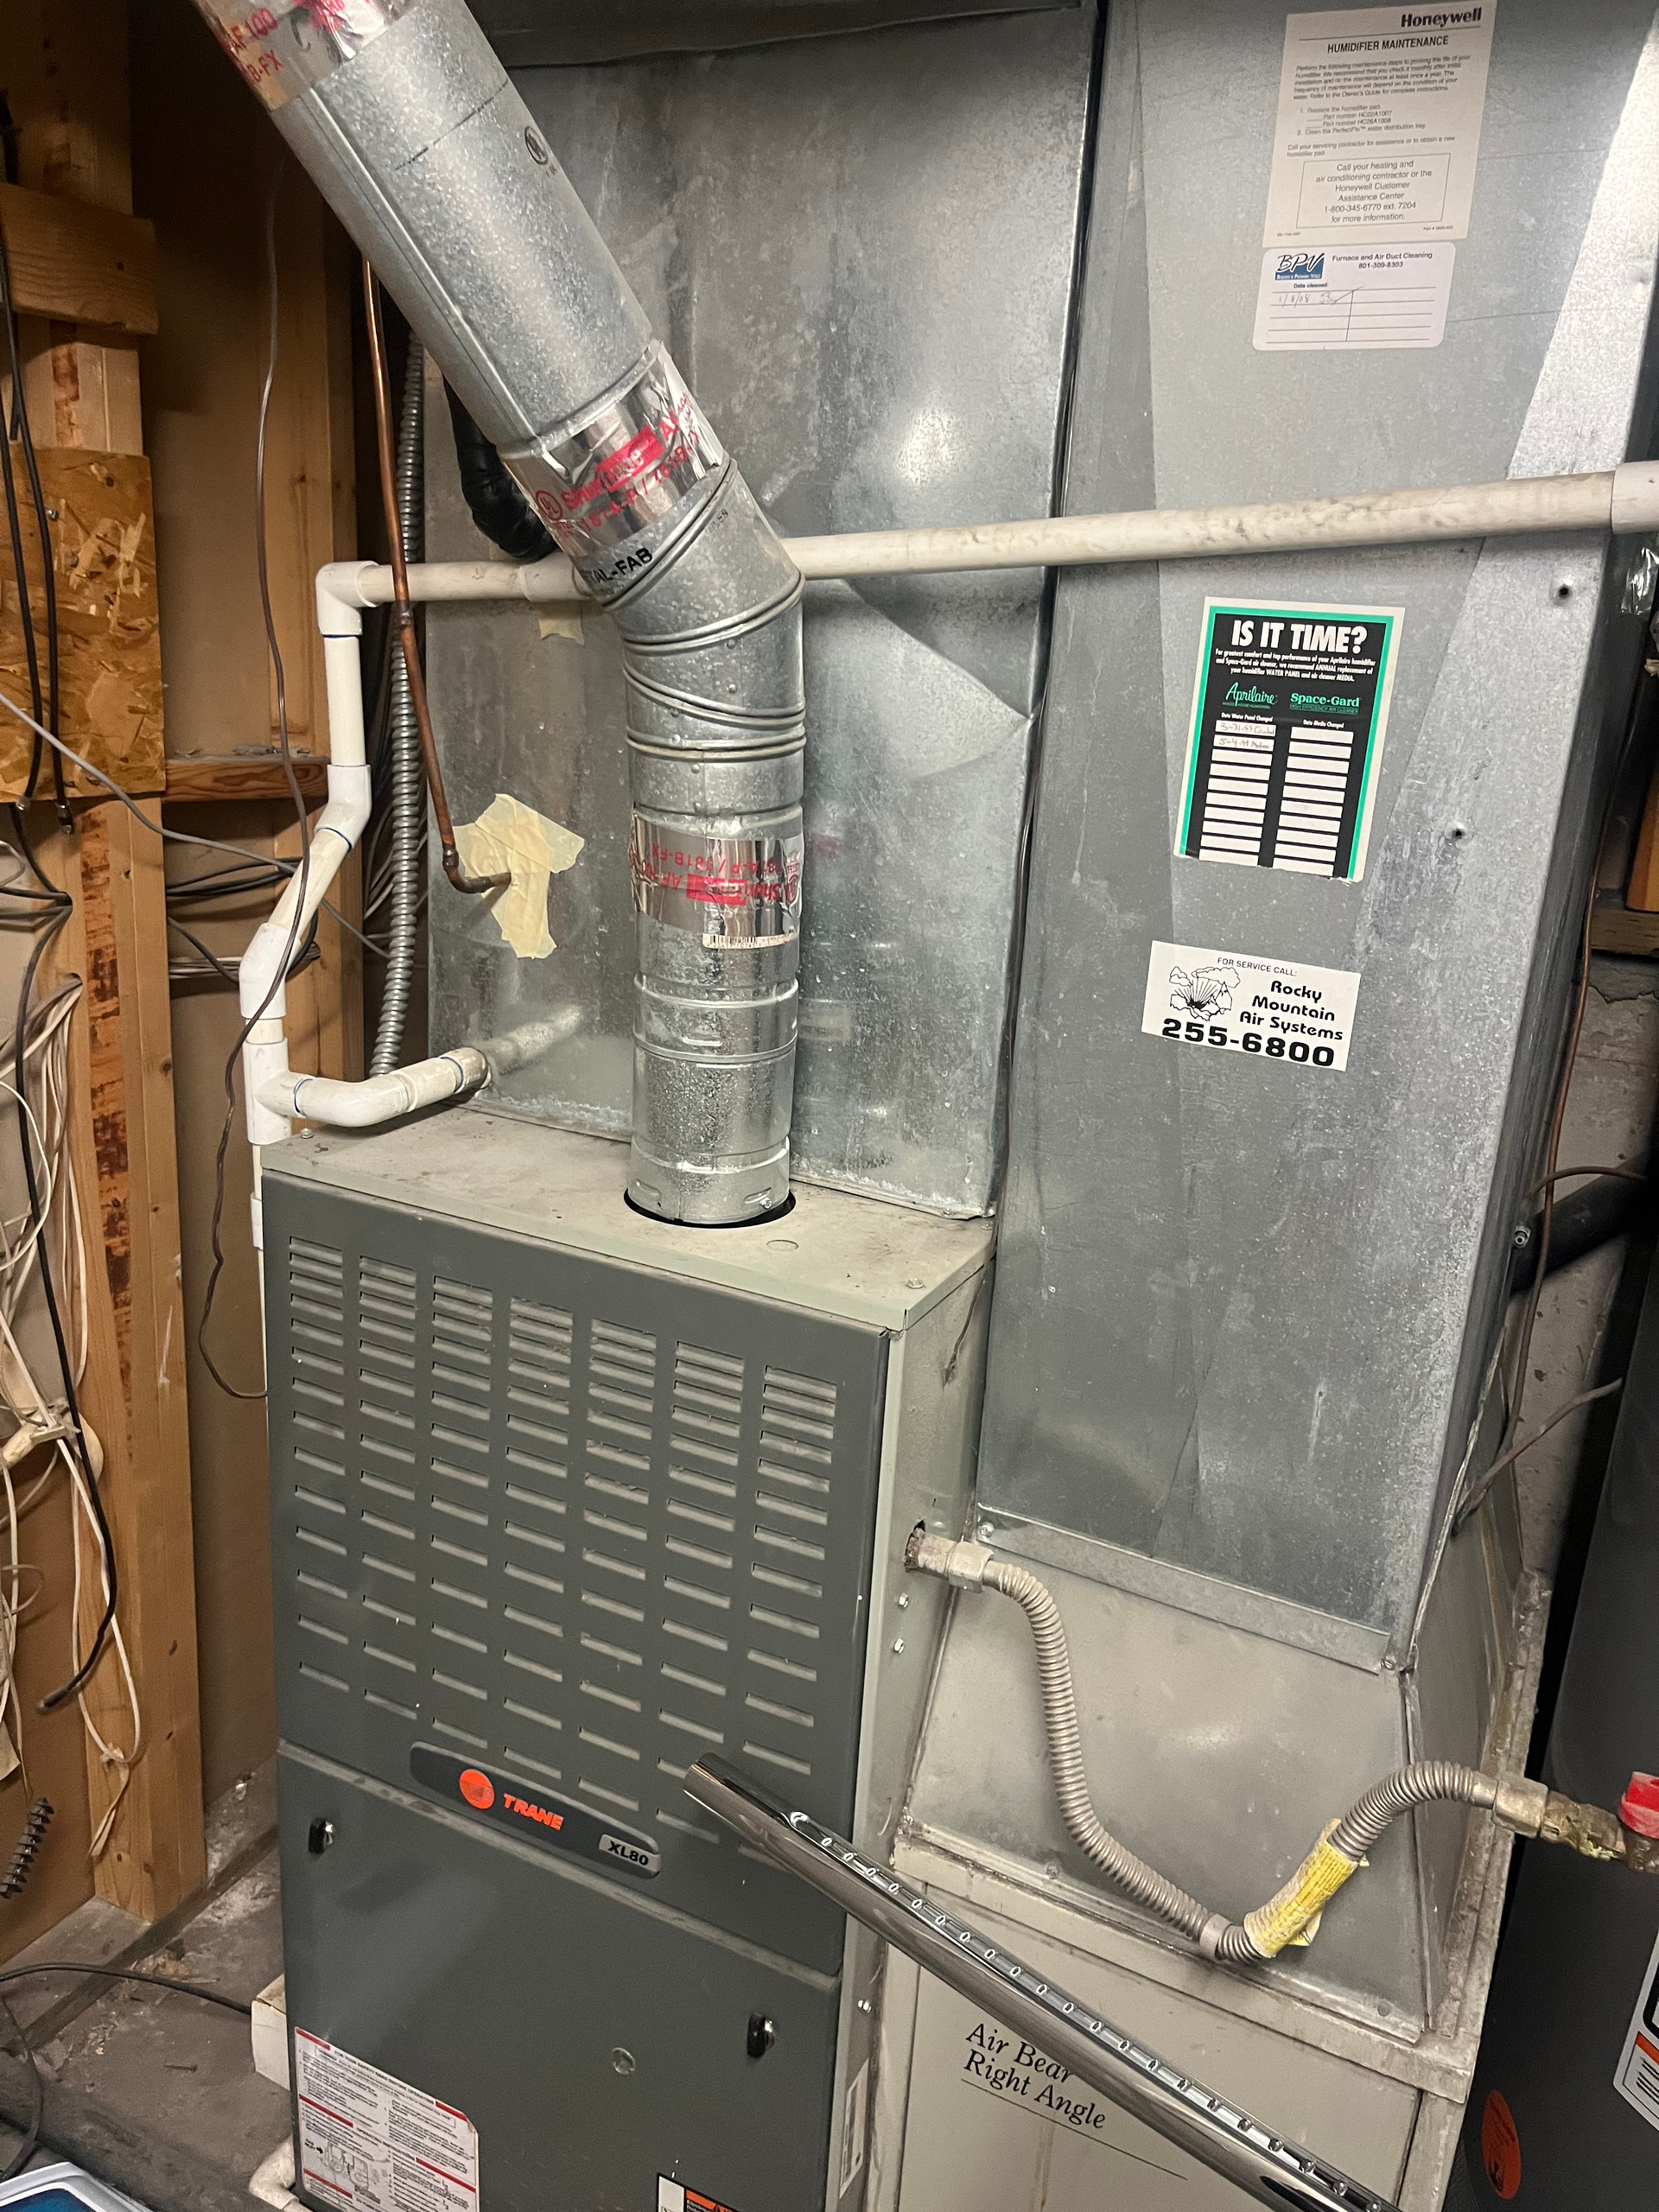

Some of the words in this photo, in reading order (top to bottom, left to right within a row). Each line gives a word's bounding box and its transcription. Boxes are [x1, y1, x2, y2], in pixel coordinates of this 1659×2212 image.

[245, 7, 278, 37] 100
[1401, 7, 1483, 28] Honeywell
[1327, 40, 1380, 54] HUMIDIFIER
[1382, 35, 1449, 50] MAINTENANCE
[1335, 183, 1372, 192] Honeywell
[1375, 181, 1410, 190] Customer
[1325, 204, 1381, 213] 1-800-345-6770
[1278, 252, 1325, 272] BPV
[1231, 620, 1255, 646] IS
[1260, 622, 1285, 648] IT
[1290, 624, 1368, 654] TIME?
[1225, 682, 1277, 707] Aprilaire
[1290, 693, 1360, 707] Space-Gard
[1217, 957, 1234, 967] FOR
[1236, 960, 1272, 972] SERVICE
[1274, 966, 1298, 976] CALL:
[1270, 980, 1322, 1003] Rocky
[1252, 995, 1335, 1021] Mountain
[1240, 1011, 1264, 1026] Air
[1269, 1016, 1343, 1040] Systems
[1162, 1018, 1334, 1066] 255-6800
[503, 1794, 563, 1830] TRANE
[607, 1840, 648, 1866] XL80
[966, 2024, 1009, 2053] Air
[1014, 2041, 1071, 2083] Bear
[963, 2049, 1031, 2095] Right
[1034, 2084, 1105, 2129] Angle
